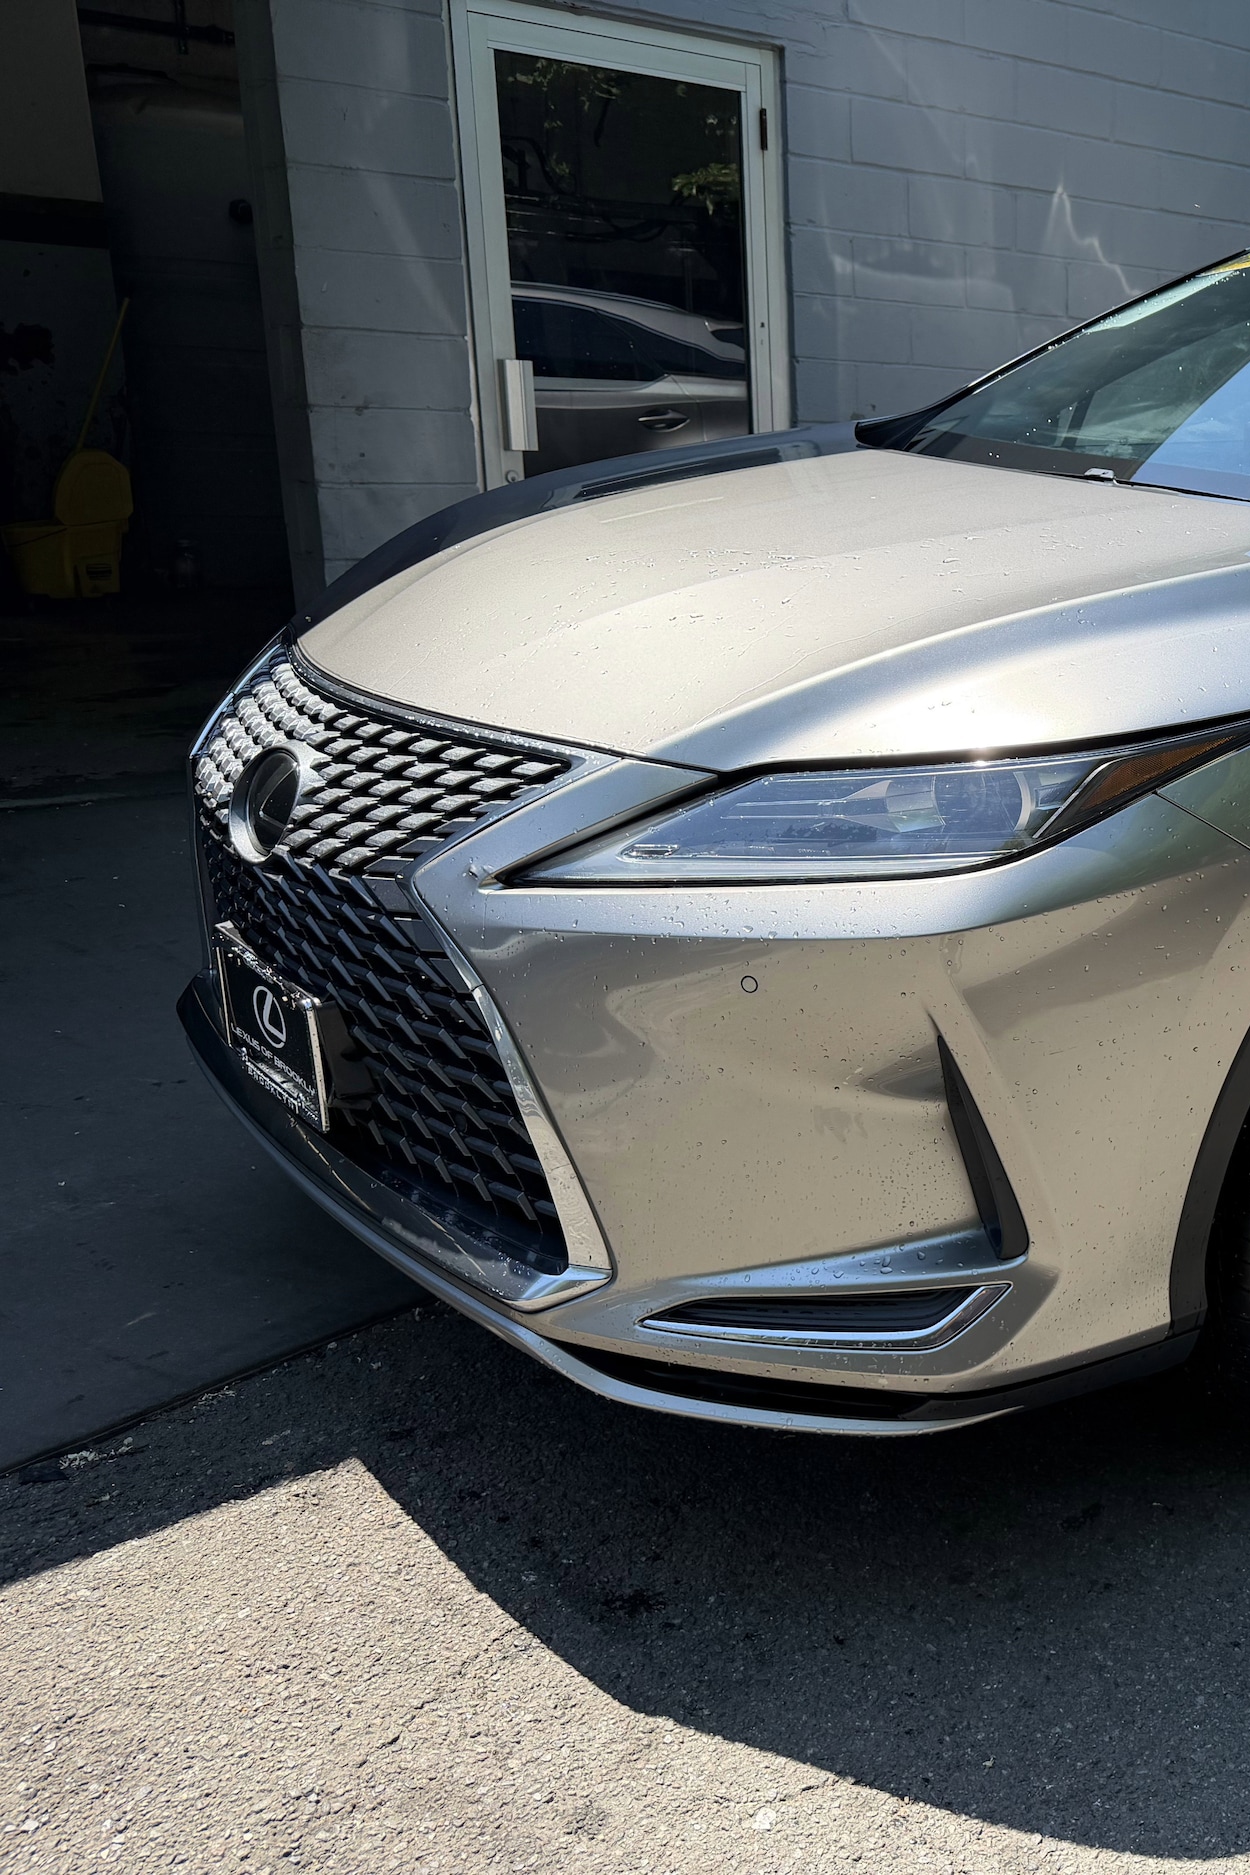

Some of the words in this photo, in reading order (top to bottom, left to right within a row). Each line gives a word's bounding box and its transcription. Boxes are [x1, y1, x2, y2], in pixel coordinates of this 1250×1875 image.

[230, 1022, 260, 1052] LEXUS
[261, 1046, 274, 1061] OF
[273, 1055, 316, 1096] BROOKLY
